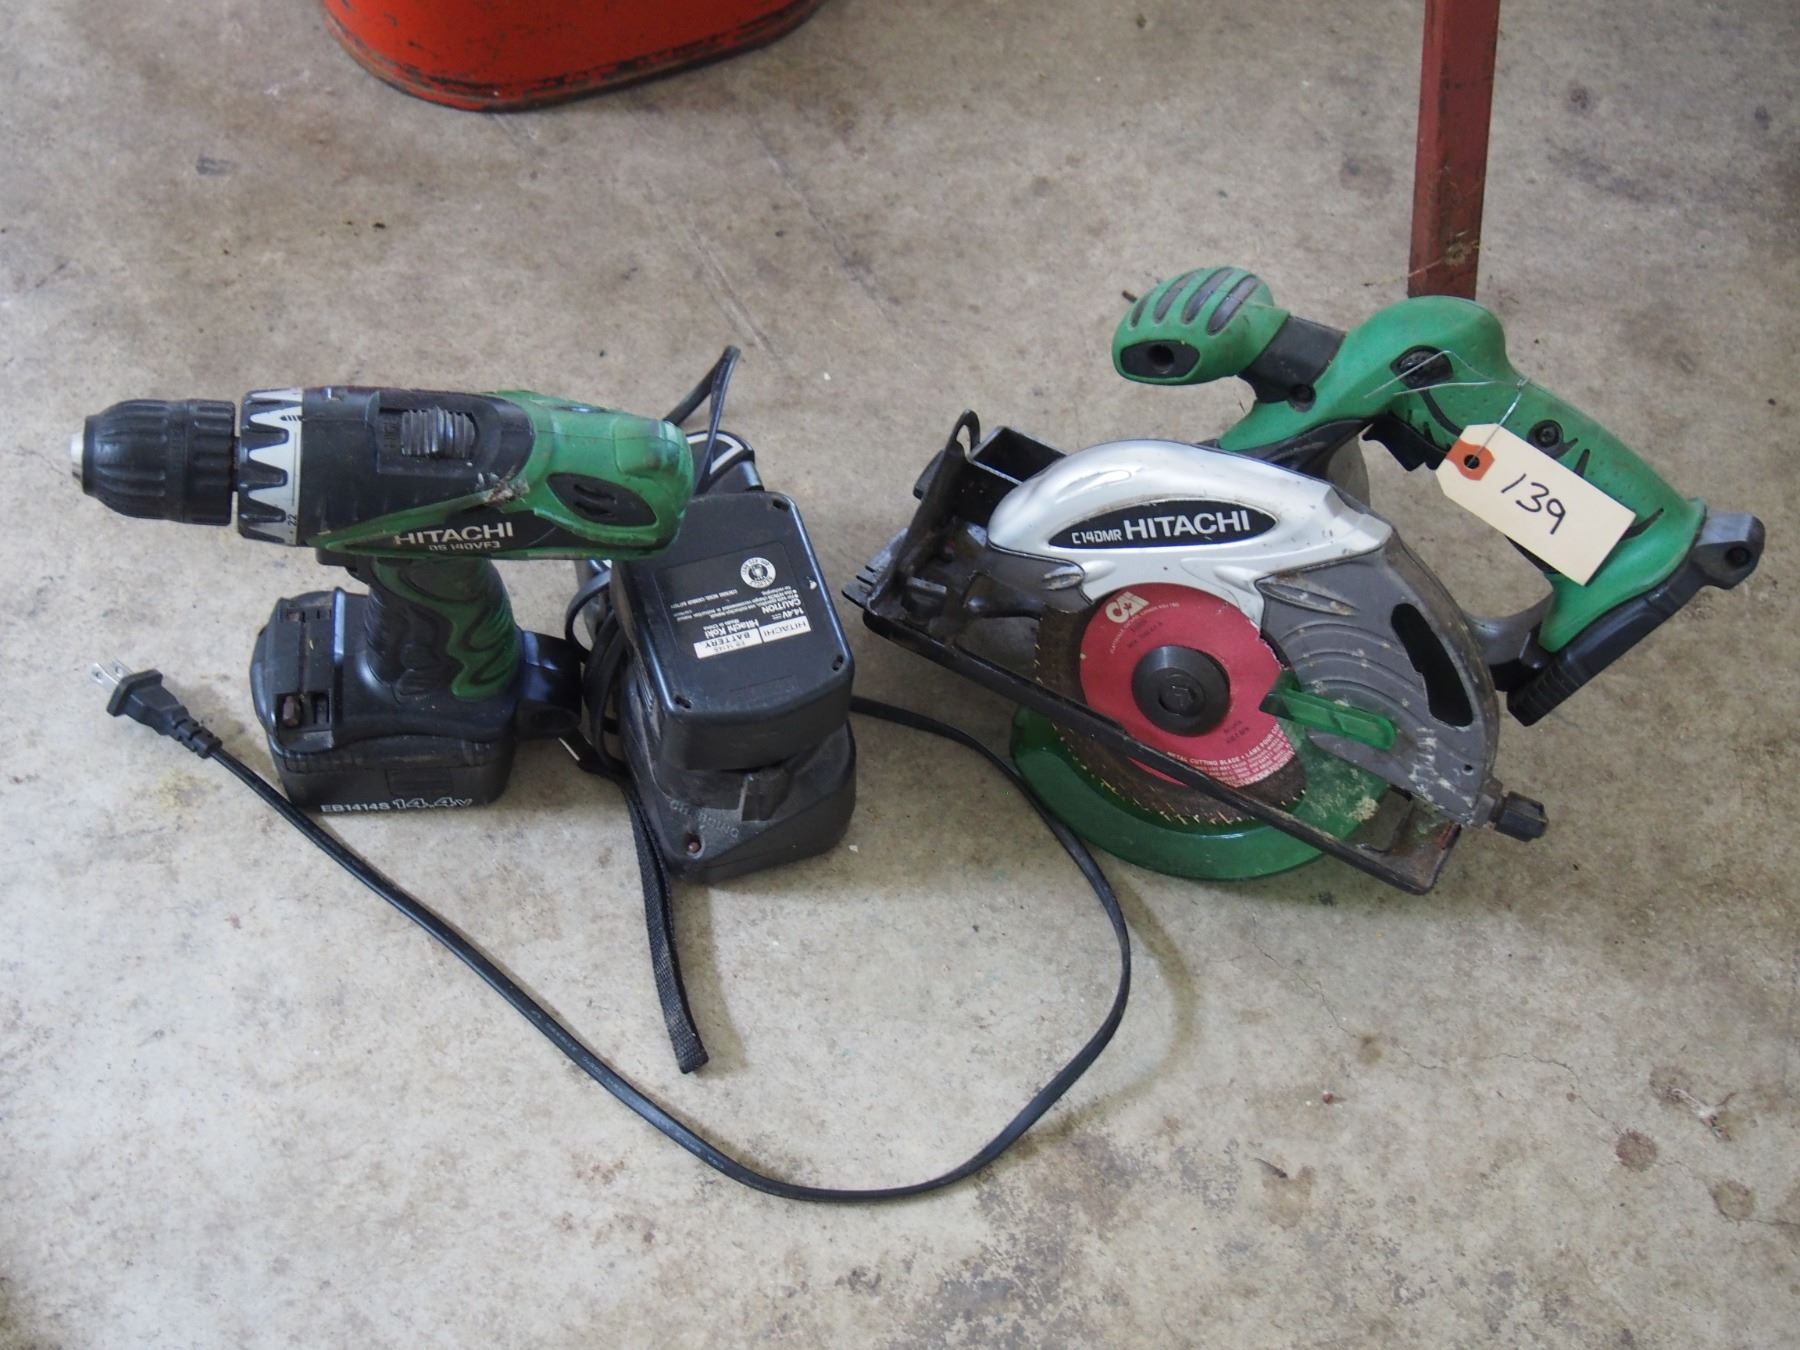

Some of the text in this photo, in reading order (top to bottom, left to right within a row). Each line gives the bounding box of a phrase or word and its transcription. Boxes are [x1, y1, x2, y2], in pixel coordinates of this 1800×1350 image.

[1501, 473, 1566, 535] 139
[287, 513, 297, 527] 22
[1072, 510, 1250, 544] C14DMR HITACHI
[394, 522, 513, 545] HITACHI
[761, 598, 802, 614] CAUTION
[782, 606, 804, 619] 14.4V
[704, 619, 760, 639] Hitachi Koki
[764, 622, 806, 637] HITACHI
[705, 631, 751, 648] BATTERY
[320, 802, 391, 812] EB1414S
